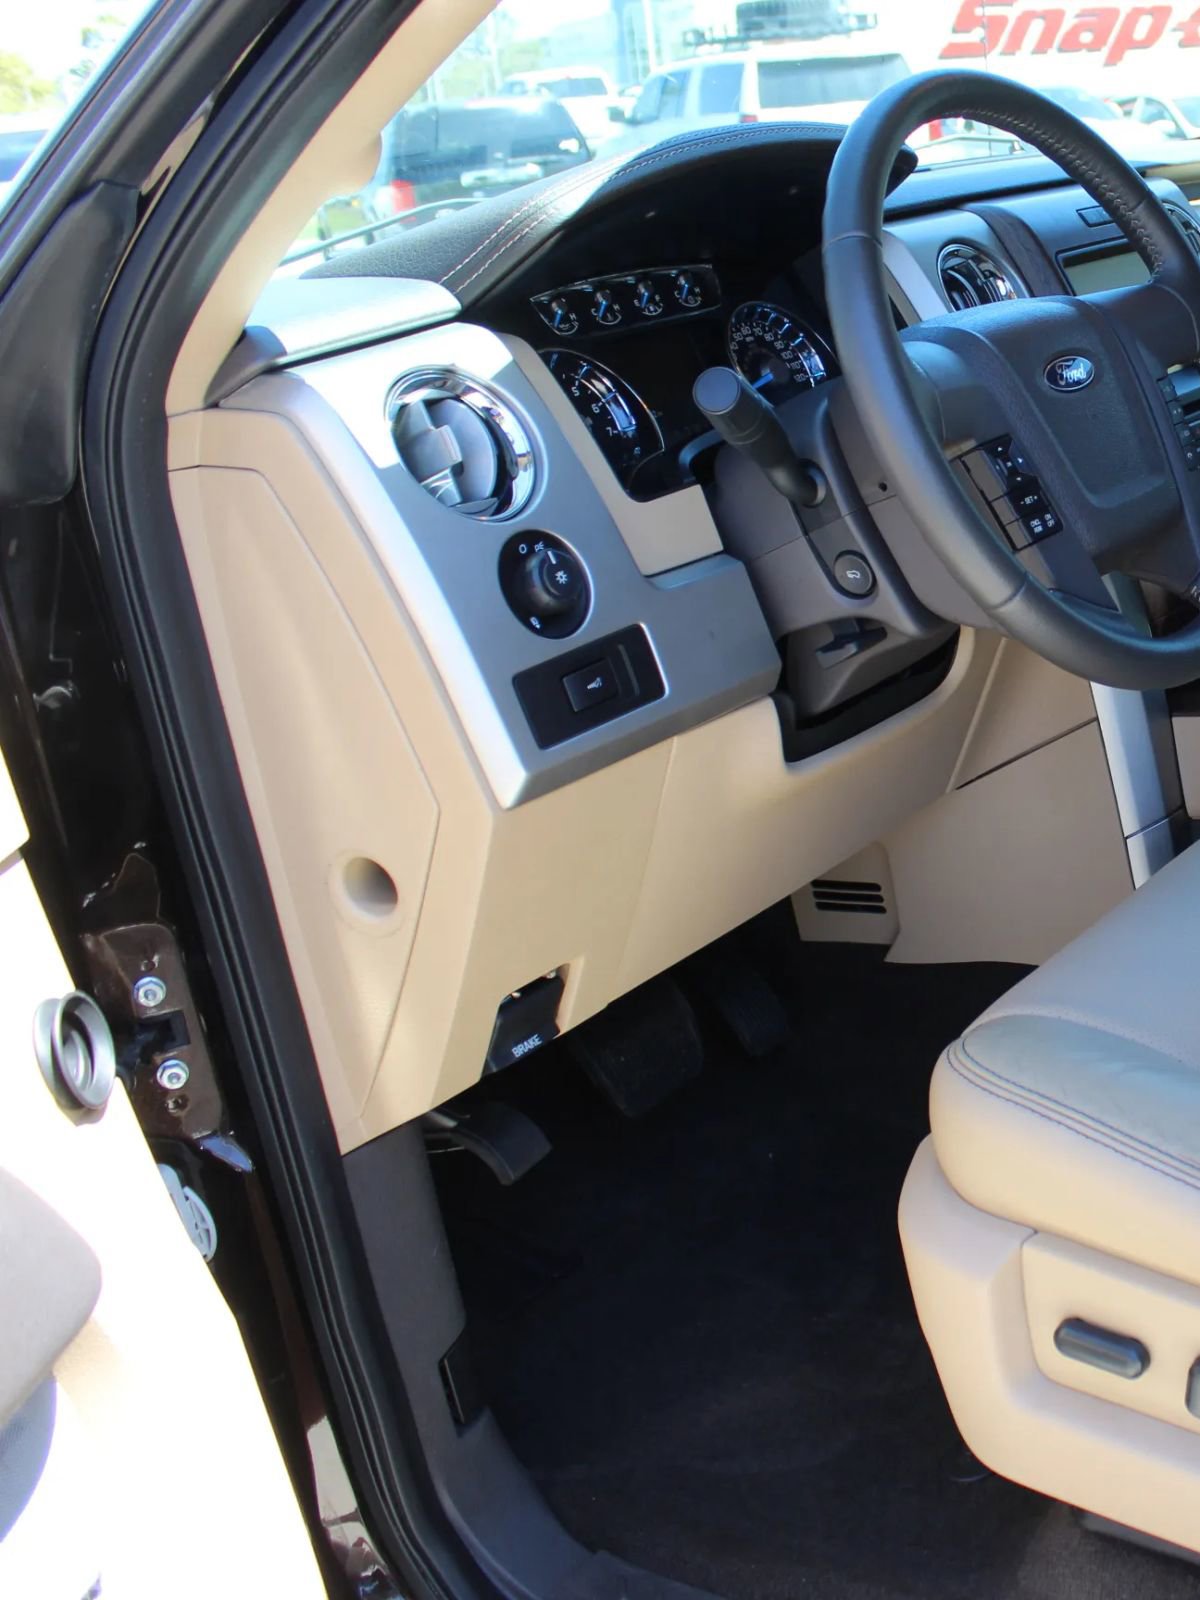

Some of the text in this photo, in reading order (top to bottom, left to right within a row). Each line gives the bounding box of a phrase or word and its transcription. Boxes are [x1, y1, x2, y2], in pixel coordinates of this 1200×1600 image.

[1055, 359, 1087, 386] Ford
[571, 386, 580, 397] 5
[591, 403, 600, 413] 6
[606, 426, 613, 437] 7
[512, 1034, 542, 1058] BRAKE
